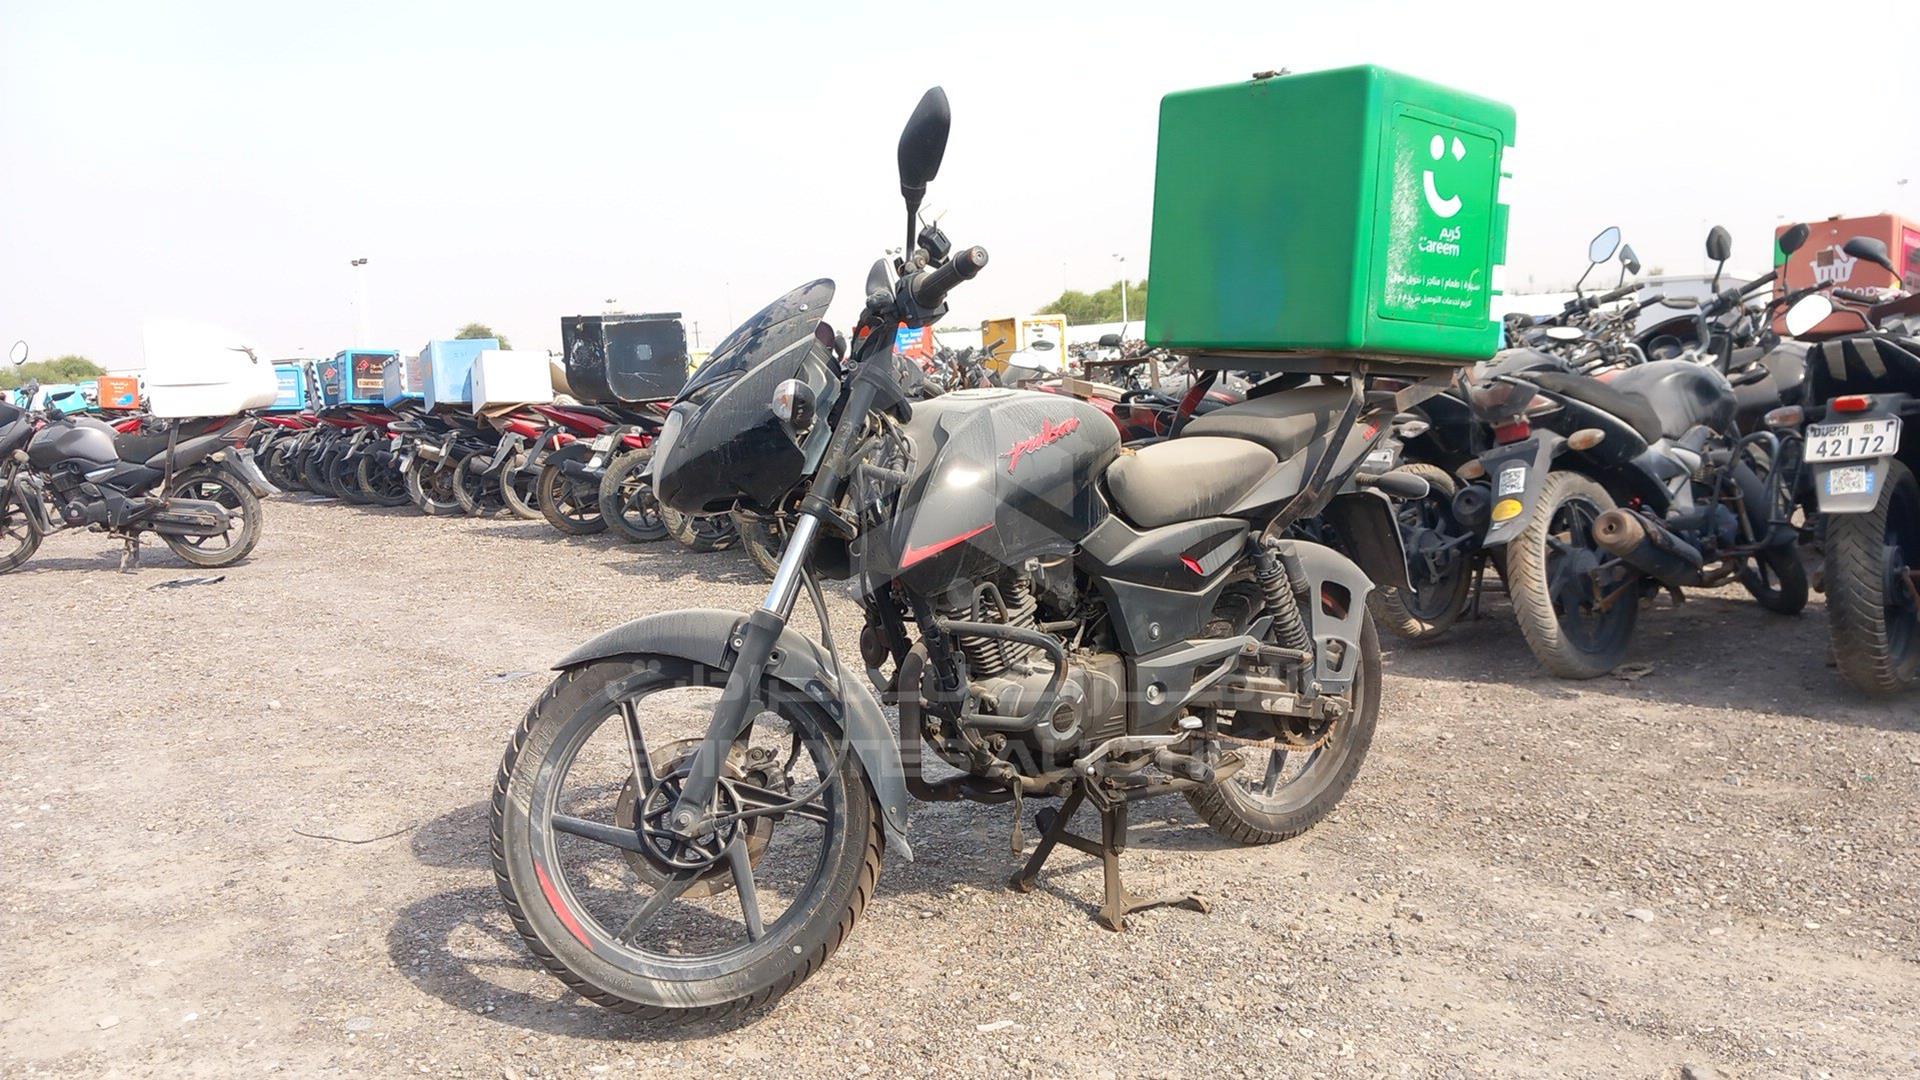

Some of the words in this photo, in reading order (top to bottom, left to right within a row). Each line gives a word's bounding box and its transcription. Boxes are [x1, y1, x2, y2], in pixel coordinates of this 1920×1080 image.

[1439, 226, 1462, 242] كريم
[1418, 237, 1460, 257] Careem
[1816, 435, 1884, 458] 42172
